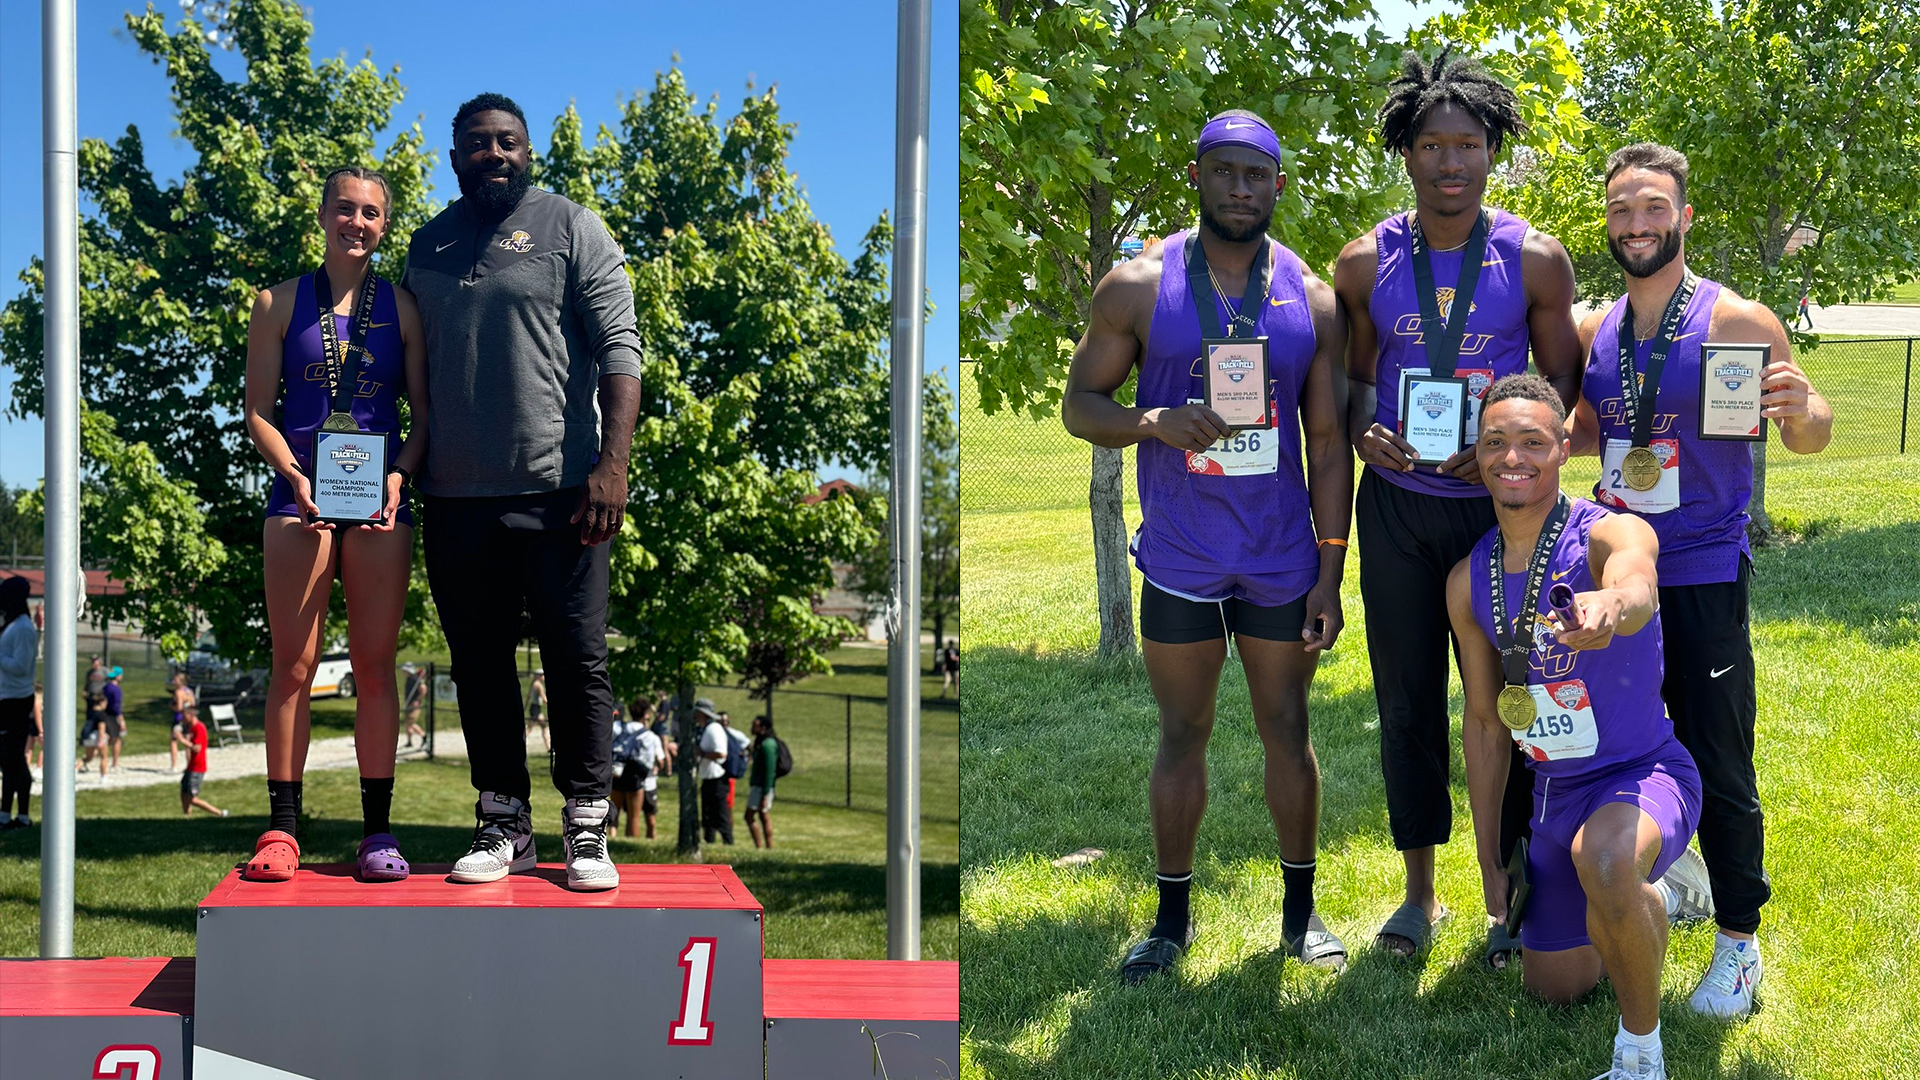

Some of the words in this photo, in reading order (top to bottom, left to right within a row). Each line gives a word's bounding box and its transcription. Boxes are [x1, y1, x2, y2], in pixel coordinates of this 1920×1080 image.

[1651, 352, 1667, 361] 2023
[1206, 431, 1261, 453] 156
[1524, 521, 1563, 633] ALL-AMERICAN
[1525, 569, 1535, 600] OUTDOOR
[1531, 553, 1540, 570] TRACK
[1538, 533, 1547, 549] FIELD
[1513, 644, 1530, 655] 2023
[667, 936, 717, 1046] 1
